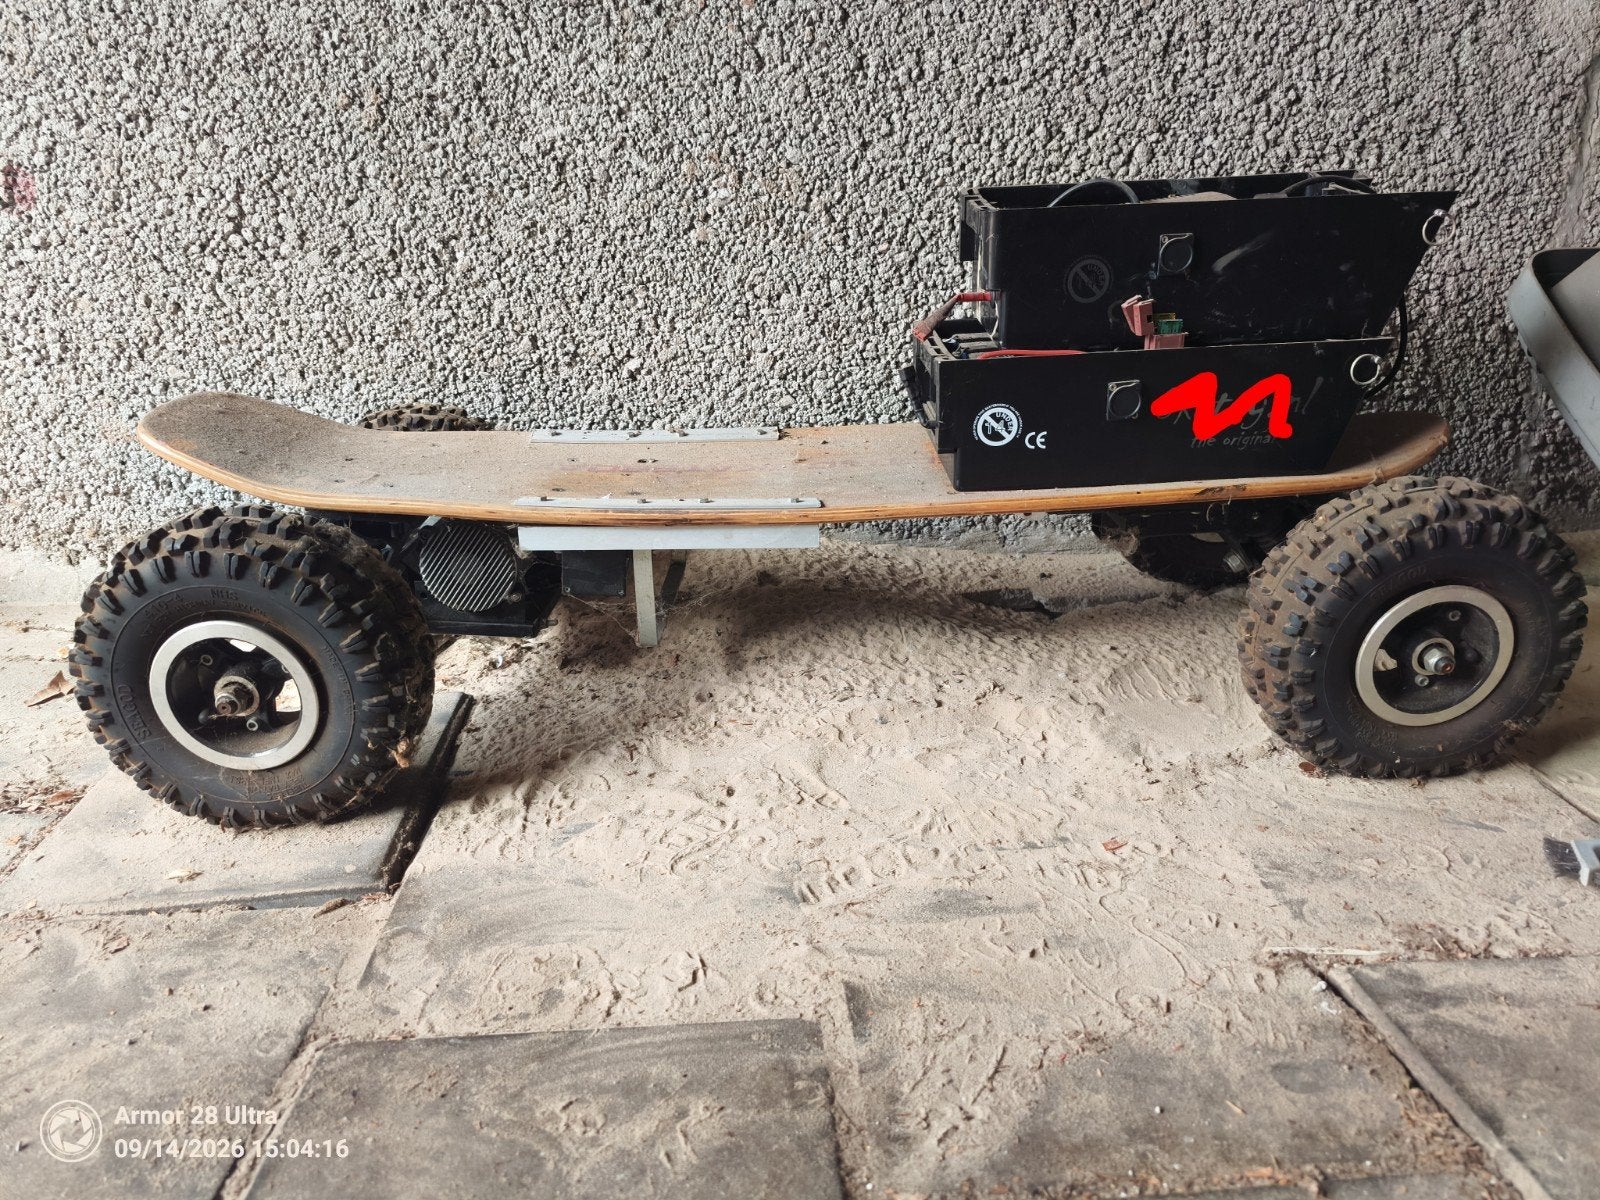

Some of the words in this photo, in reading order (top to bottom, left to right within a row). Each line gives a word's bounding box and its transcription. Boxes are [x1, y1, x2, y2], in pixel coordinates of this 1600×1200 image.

[995, 411, 1014, 431] UNDER
[1025, 431, 1048, 449] CE
[1223, 431, 1276, 450] origina
